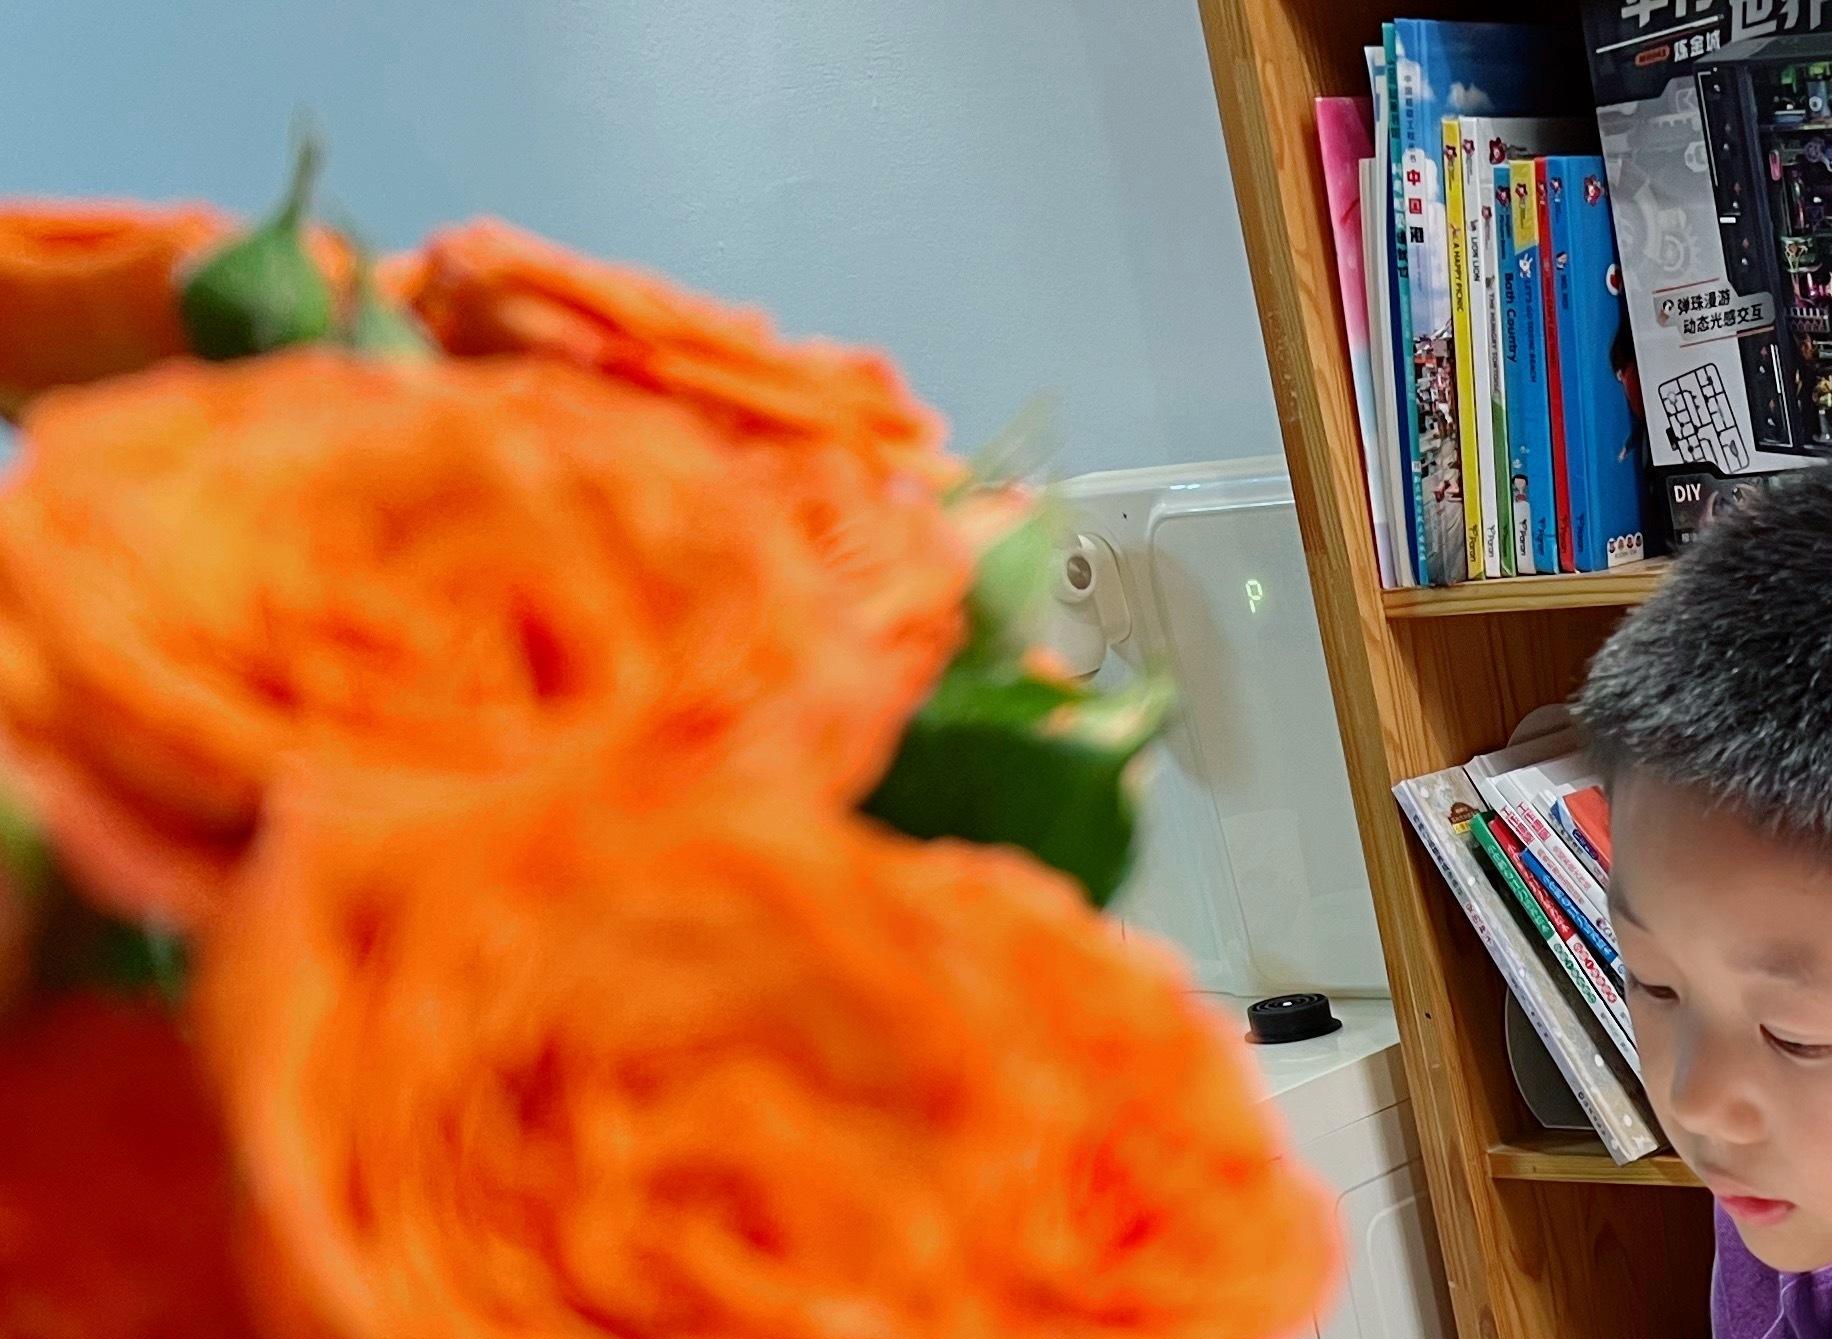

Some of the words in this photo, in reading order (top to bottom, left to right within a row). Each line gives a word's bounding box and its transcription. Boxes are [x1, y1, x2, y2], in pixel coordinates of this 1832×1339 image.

[1505, 273, 1515, 307] Bath
[1677, 287, 1731, 316] 弹珠漫游
[1683, 303, 1764, 334] 动态光感交互
[1507, 311, 1518, 363] Country
[1674, 484, 1702, 503] DIY
